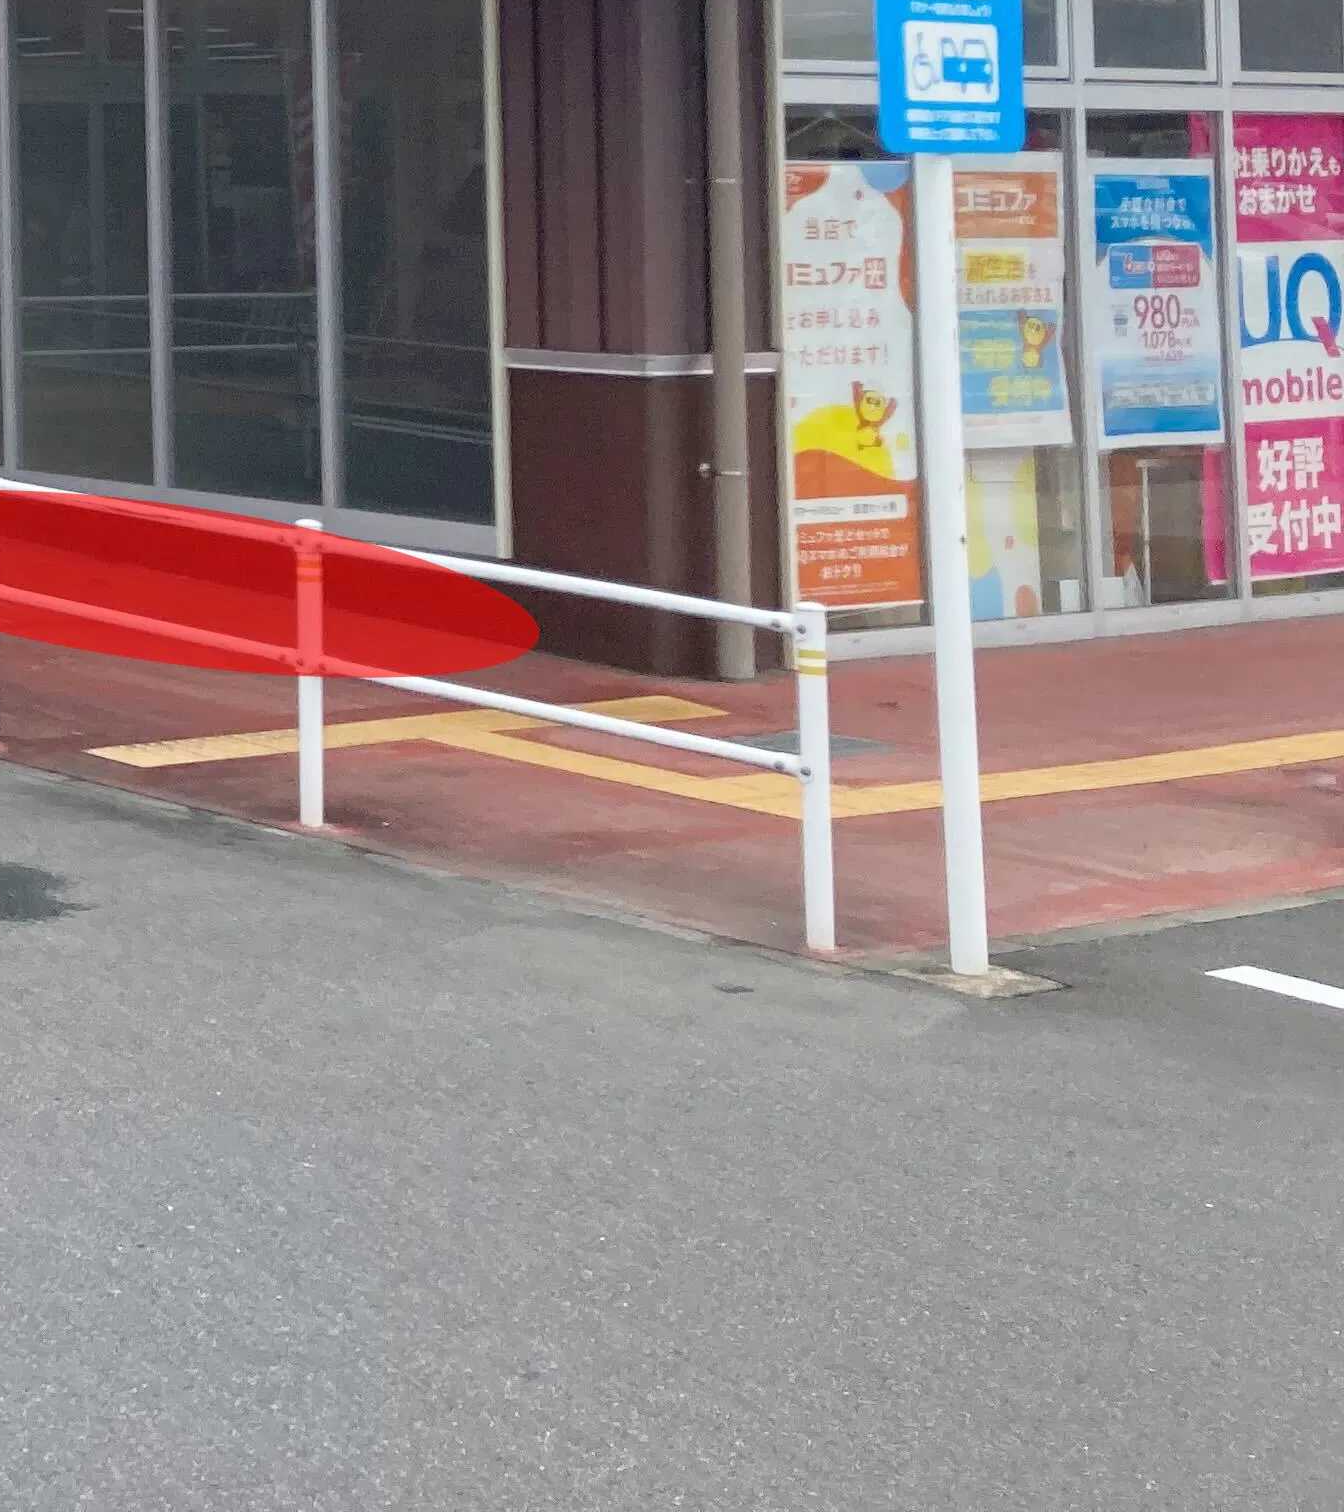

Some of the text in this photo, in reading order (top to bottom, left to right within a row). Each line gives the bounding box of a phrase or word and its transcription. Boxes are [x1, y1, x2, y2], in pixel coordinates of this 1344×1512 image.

[1239, 184, 1317, 216] おまかせ
[804, 218, 857, 240] 当店で
[1134, 294, 1181, 330] 980
[1236, 252, 1342, 358] UQ
[1241, 366, 1343, 406] mobile
[1257, 436, 1325, 492] 好評
[1247, 496, 1341, 555] 受付中
